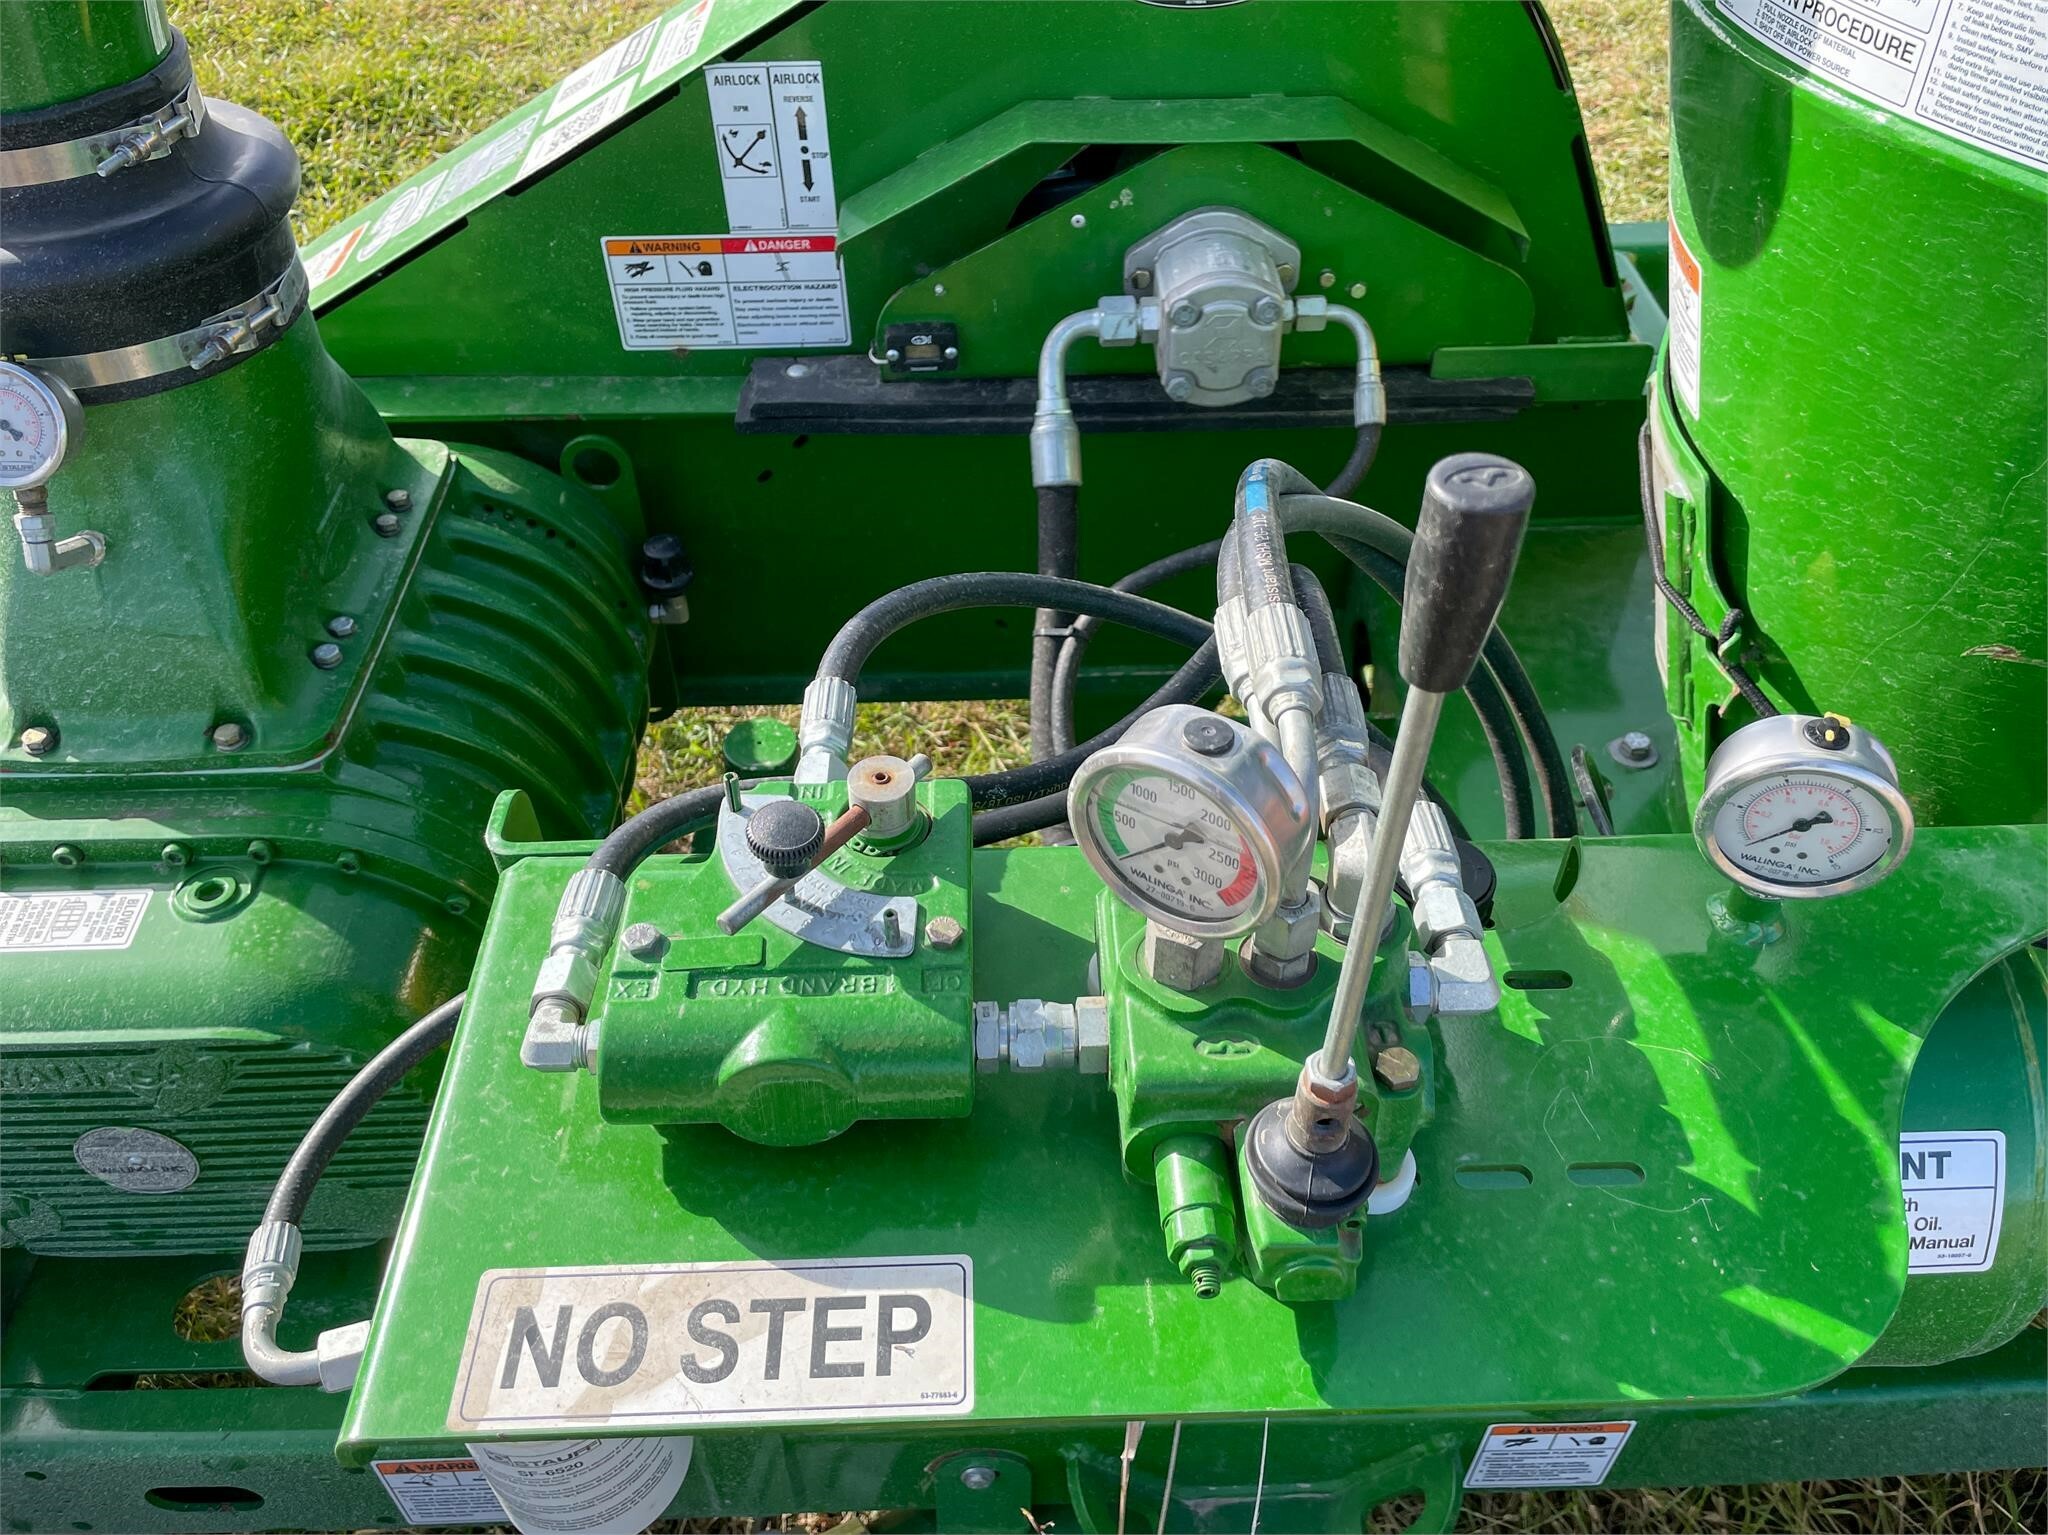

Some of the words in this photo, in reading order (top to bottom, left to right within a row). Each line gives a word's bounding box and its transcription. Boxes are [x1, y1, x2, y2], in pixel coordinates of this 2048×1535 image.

[1966, 6, 1984, 18] Keep
[1761, 12, 1776, 26] STOP
[1775, 21, 1788, 34] THE
[1786, 27, 1815, 47] AIRLOCK
[1763, 2, 1778, 17] PULL
[1777, 11, 1800, 30] NOZZLE
[1799, 23, 1814, 39] OUT
[1813, 31, 1824, 41] OF
[1822, 36, 1857, 60] MATERIAL
[1802, 0, 1919, 64] PROCEDURE
[1960, 24, 1980, 37] Clean
[2016, 44, 2034, 56] SMV
[1972, 18, 1990, 29] leaks
[1990, 24, 2012, 36] before
[2014, 32, 2036, 46] using.
[1759, 22, 1774, 35] SHUT
[1772, 29, 1785, 42] OFF
[1784, 36, 1799, 51] UNIT
[1799, 44, 1822, 63] POWER
[1821, 56, 1850, 78] SOURCE
[1956, 35, 1978, 49] Install
[1978, 44, 1999, 58] safety
[2019, 58, 2044, 71] before
[714, 74, 760, 86] AIRLOCK
[773, 73, 820, 84] AIRLOCK
[1948, 62, 1969, 76] during
[1970, 70, 1988, 82] times
[1998, 80, 2022, 94] limited
[1950, 54, 1964, 64] Add
[1964, 60, 1982, 71] extra
[1982, 66, 2003, 80] lights
[2003, 74, 2018, 84] and
[2018, 80, 2032, 88] use
[1940, 81, 1962, 95] Install
[1962, 90, 1983, 103] safety
[1982, 97, 2002, 110] chain
[2003, 106, 2022, 118] when
[1944, 71, 1958, 82] Use
[1958, 78, 1981, 91] hazard
[2018, 100, 2043, 112] tractor
[1937, 91, 1955, 104] Keep
[1955, 98, 1974, 111] away
[1974, 104, 1990, 117] from
[1990, 111, 2024, 129] overhead
[1931, 108, 1956, 124] Review
[1956, 118, 1977, 132] safety
[1976, 126, 2018, 148] instructions
[2018, 142, 2035, 154] with
[1978, 117, 1992, 127] can
[1992, 122, 2014, 134] occur
[2014, 128, 2042, 145] without
[643, 242, 702, 252] WARNING
[758, 240, 812, 250] DANGER
[1254, 542, 1273, 566] MSHA
[1130, 782, 1158, 804] 1000
[1168, 780, 1196, 802] 1500
[1114, 810, 1136, 830] 500
[1200, 808, 1232, 832] 2000
[1784, 840, 1798, 848] psi
[1167, 858, 1180, 870] psi
[1208, 848, 1240, 872] 2500
[1740, 852, 1792, 870] WALINGA
[1798, 866, 1820, 877] INC.
[1130, 866, 1184, 897] WALINGA
[1189, 894, 1214, 912] INC.
[1192, 866, 1223, 890] 3000
[110, 898, 140, 938] BLOWER
[711, 977, 770, 997] HYD
[779, 973, 879, 994] BRAND
[1914, 1216, 1942, 1232] Oil.
[1909, 1234, 1976, 1250] Manual
[500, 1300, 651, 1390] NO
[680, 1294, 933, 1384] STEP
[416, 1462, 478, 1470] WARN
[518, 1461, 584, 1476] SF-6520
